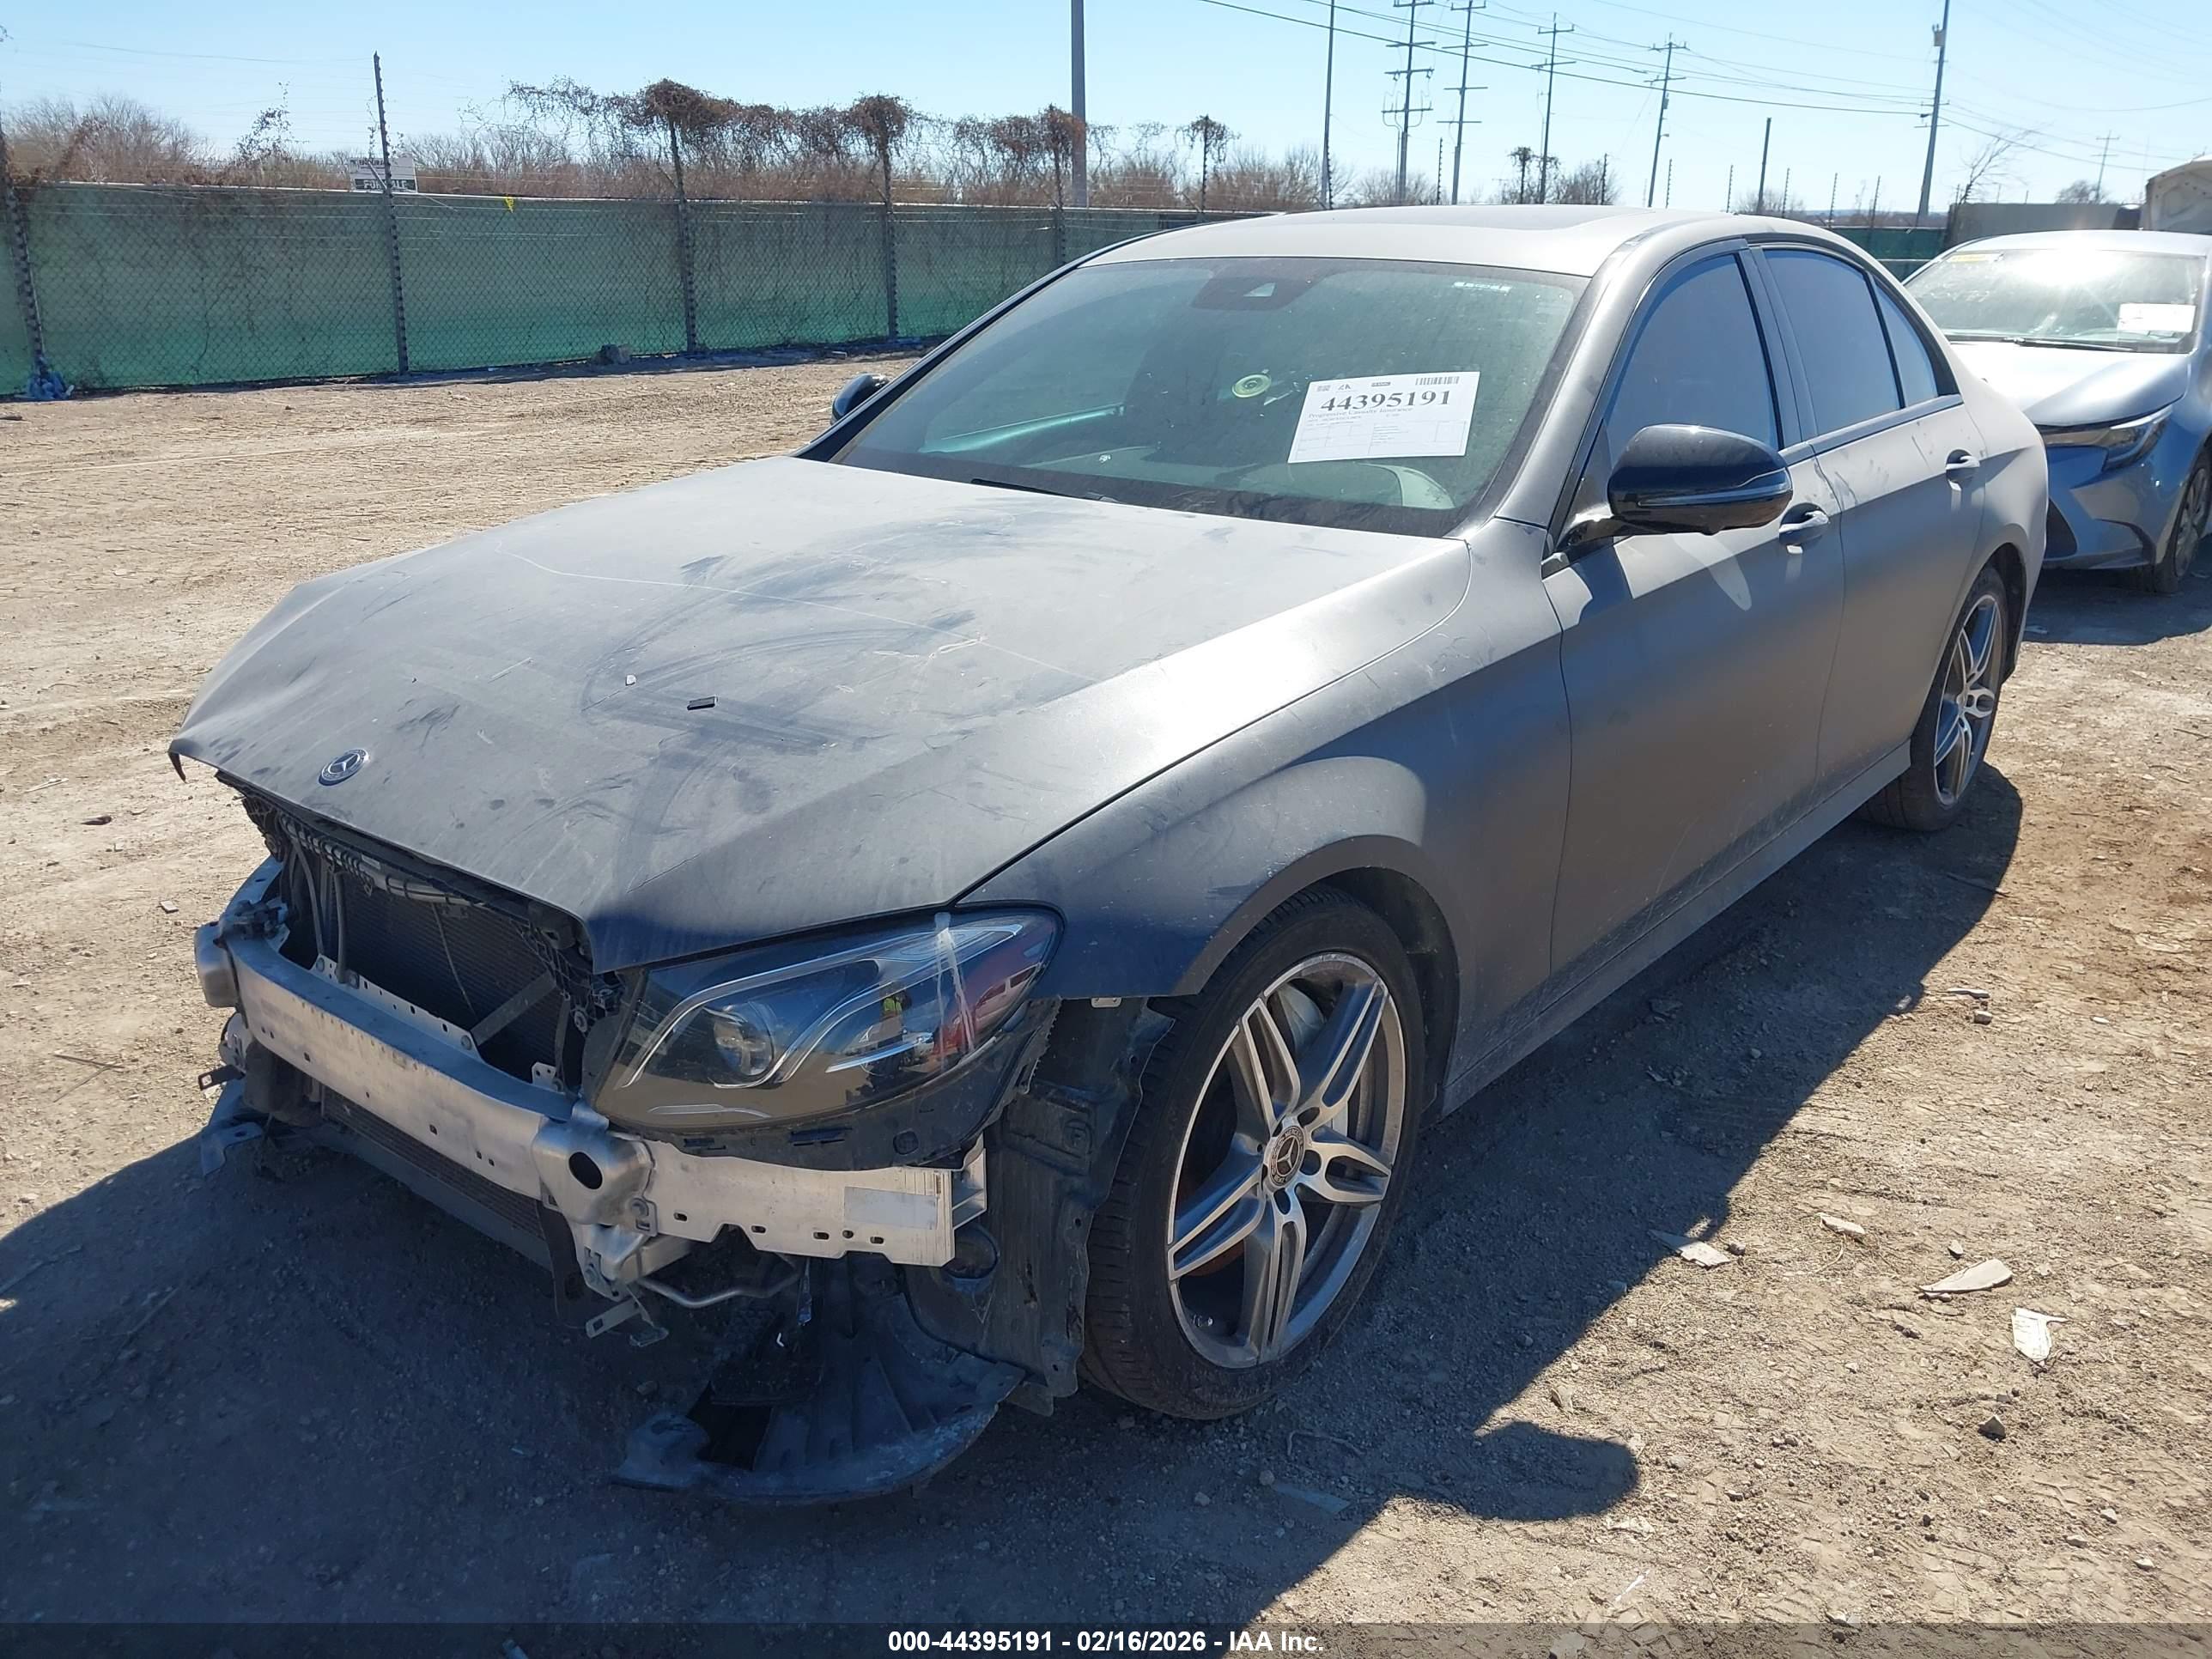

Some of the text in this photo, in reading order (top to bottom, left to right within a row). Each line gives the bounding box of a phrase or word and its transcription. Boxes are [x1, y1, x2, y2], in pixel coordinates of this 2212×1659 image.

[363, 179, 407, 189] FOR ALE
[1321, 391, 1450, 411] 44395191
